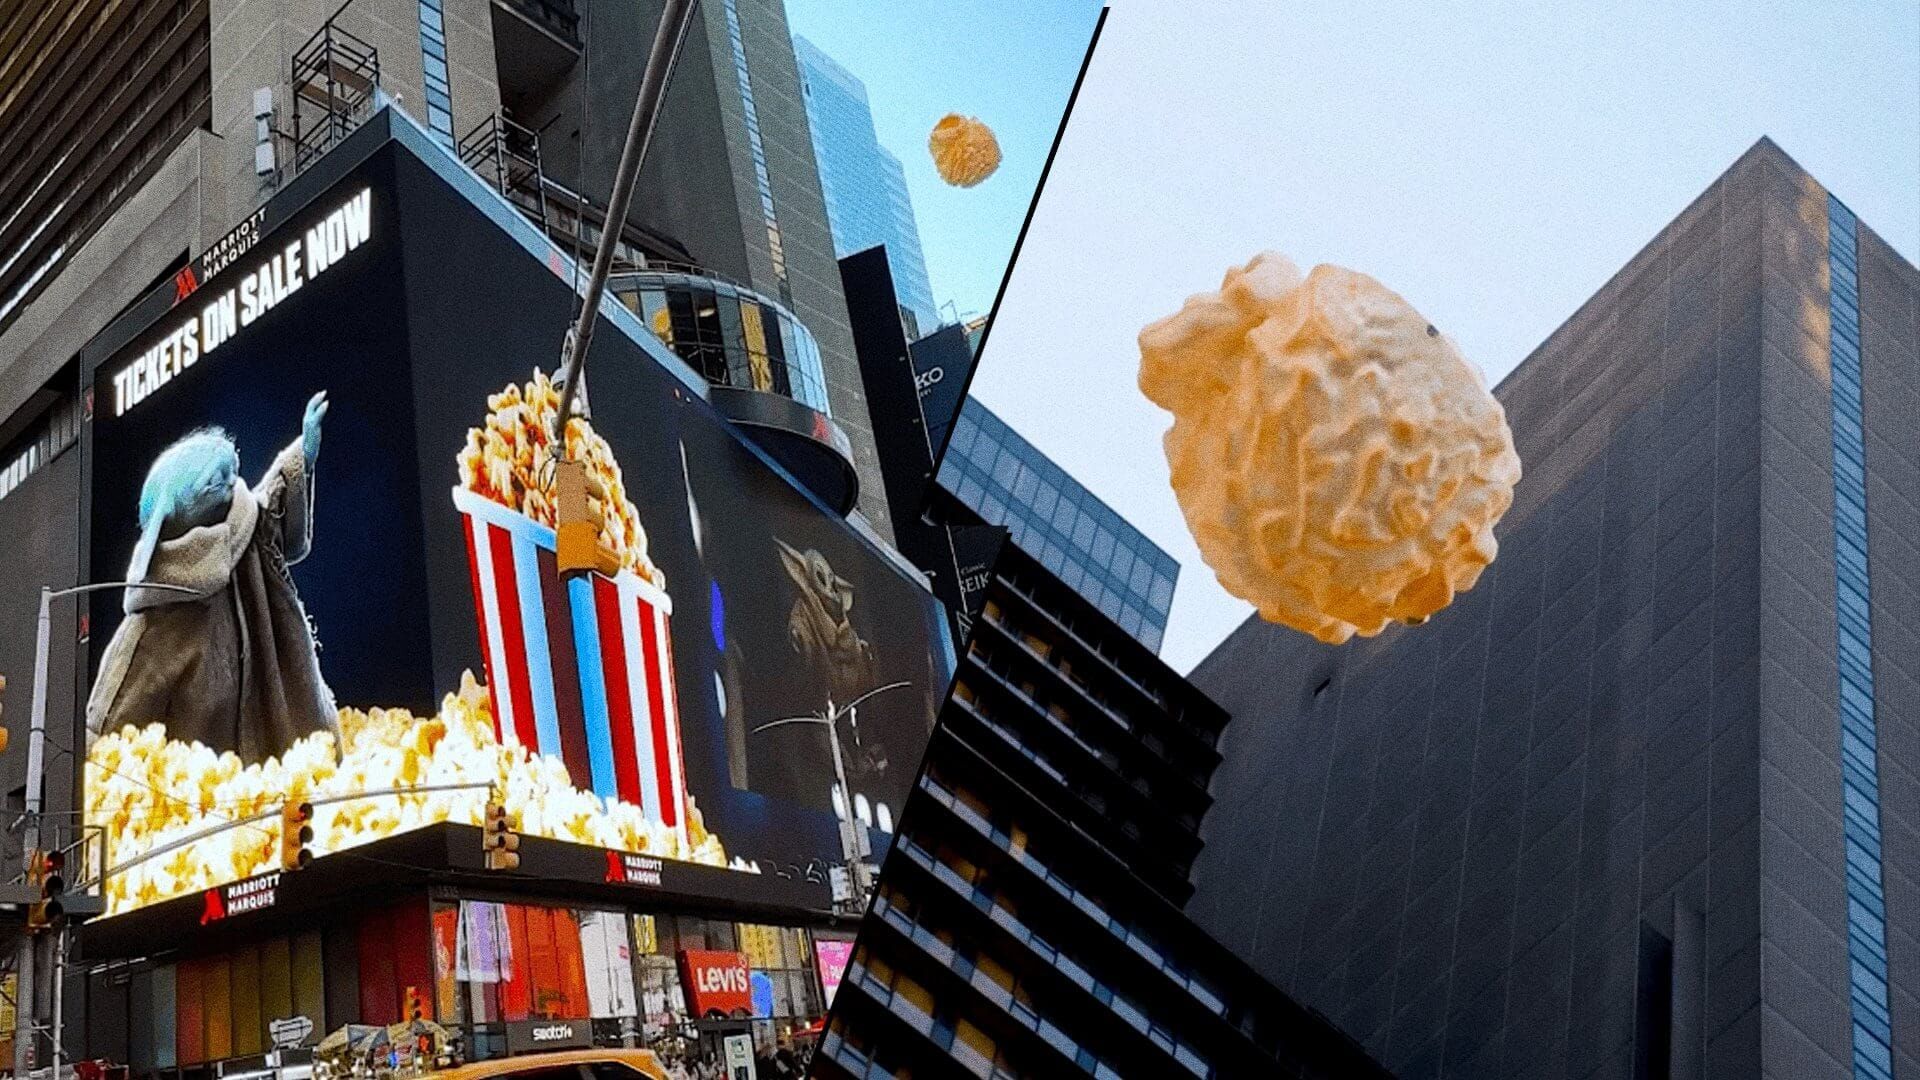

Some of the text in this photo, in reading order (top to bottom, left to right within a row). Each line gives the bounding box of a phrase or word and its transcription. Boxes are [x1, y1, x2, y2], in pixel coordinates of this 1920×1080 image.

[203, 208, 266, 267] MARRIOTT
[203, 231, 259, 283] MARQUIS
[114, 187, 372, 417] TICKETS ON SALE NOW
[228, 874, 281, 899] MARRIOTT
[228, 890, 275, 916] MARQUIS
